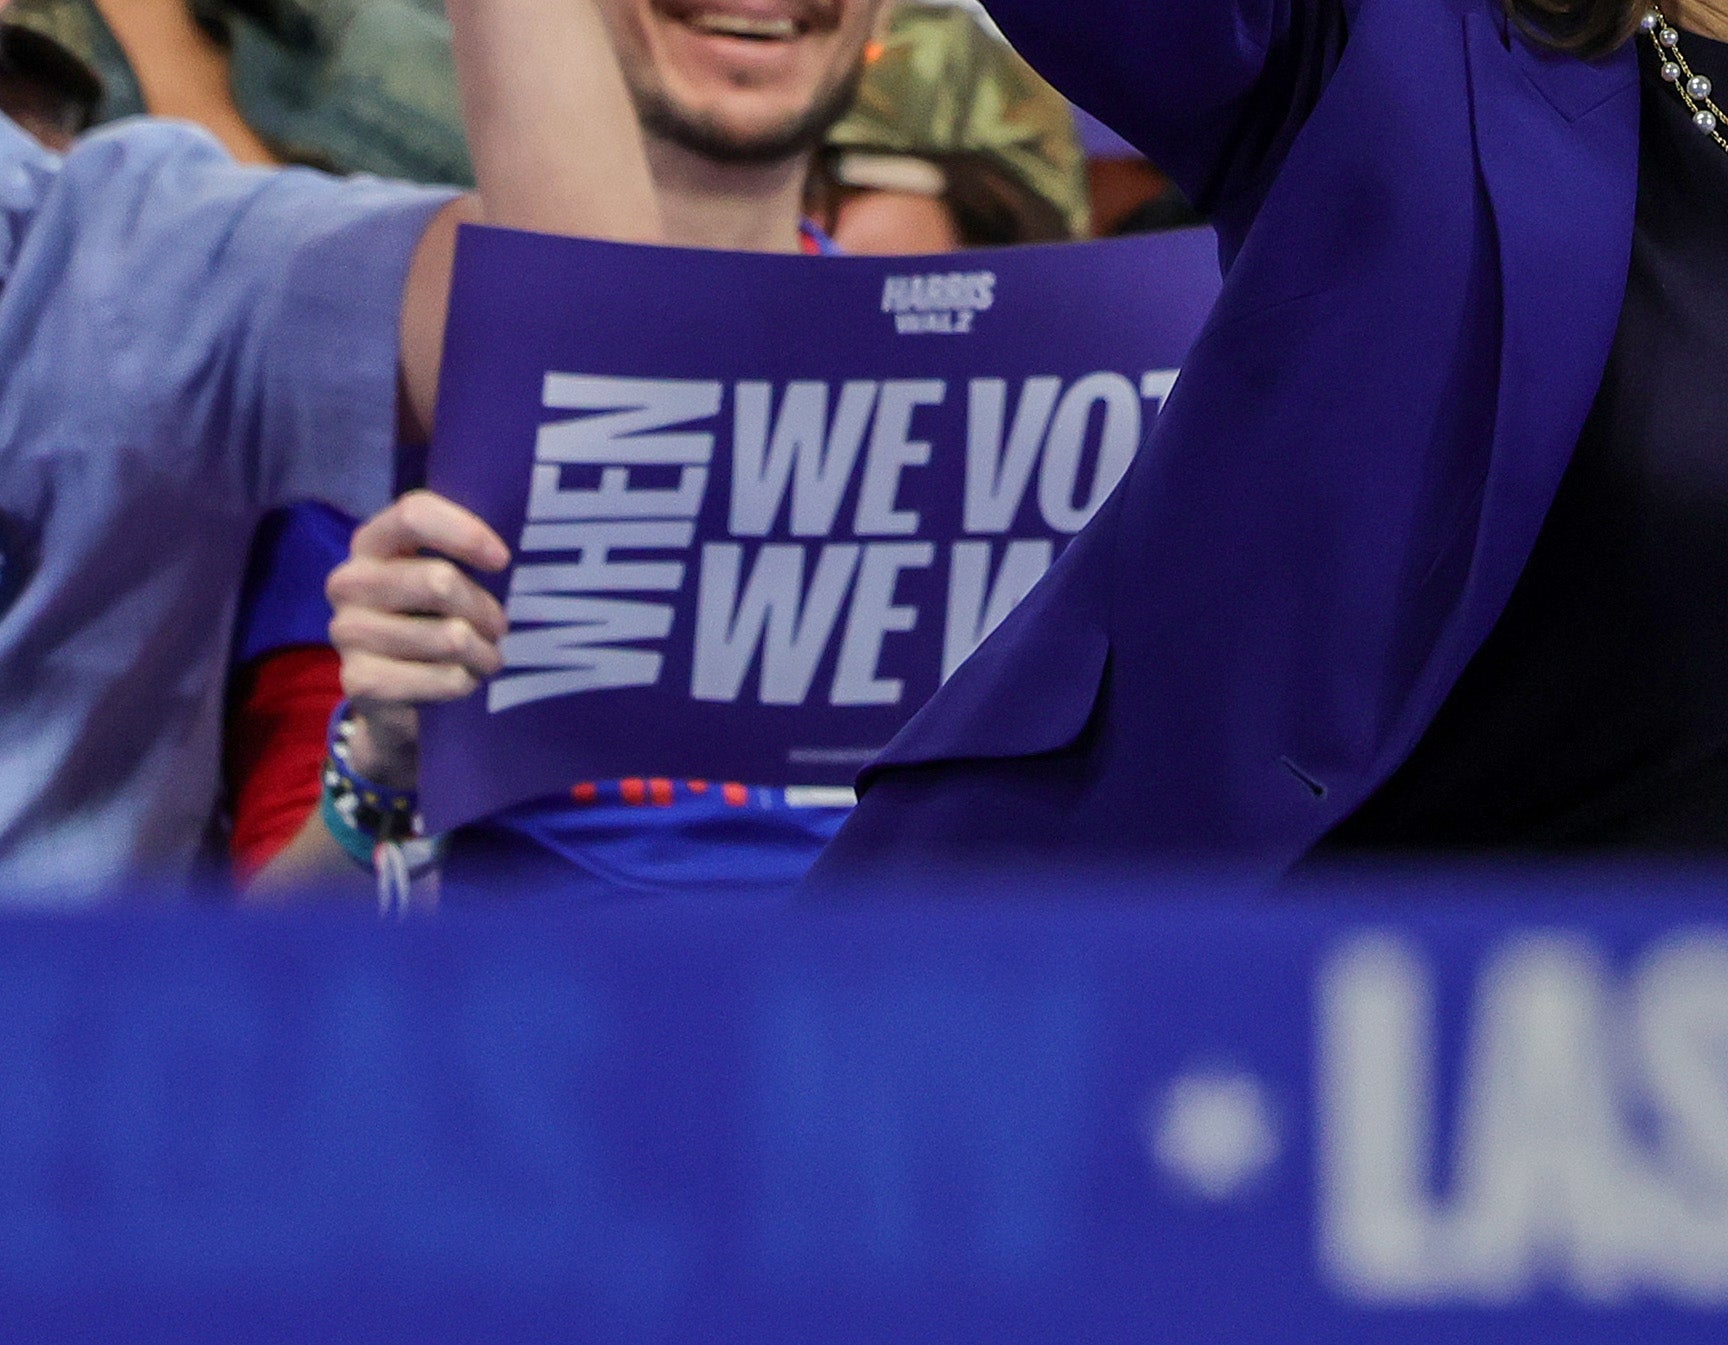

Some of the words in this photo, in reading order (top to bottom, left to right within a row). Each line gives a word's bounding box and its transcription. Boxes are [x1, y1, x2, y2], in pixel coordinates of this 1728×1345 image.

[881, 270, 997, 313] HARRIS
[894, 308, 975, 334] WALZ
[729, 379, 946, 537] WE
[487, 370, 724, 714] WHEN
[689, 541, 934, 706] WE
